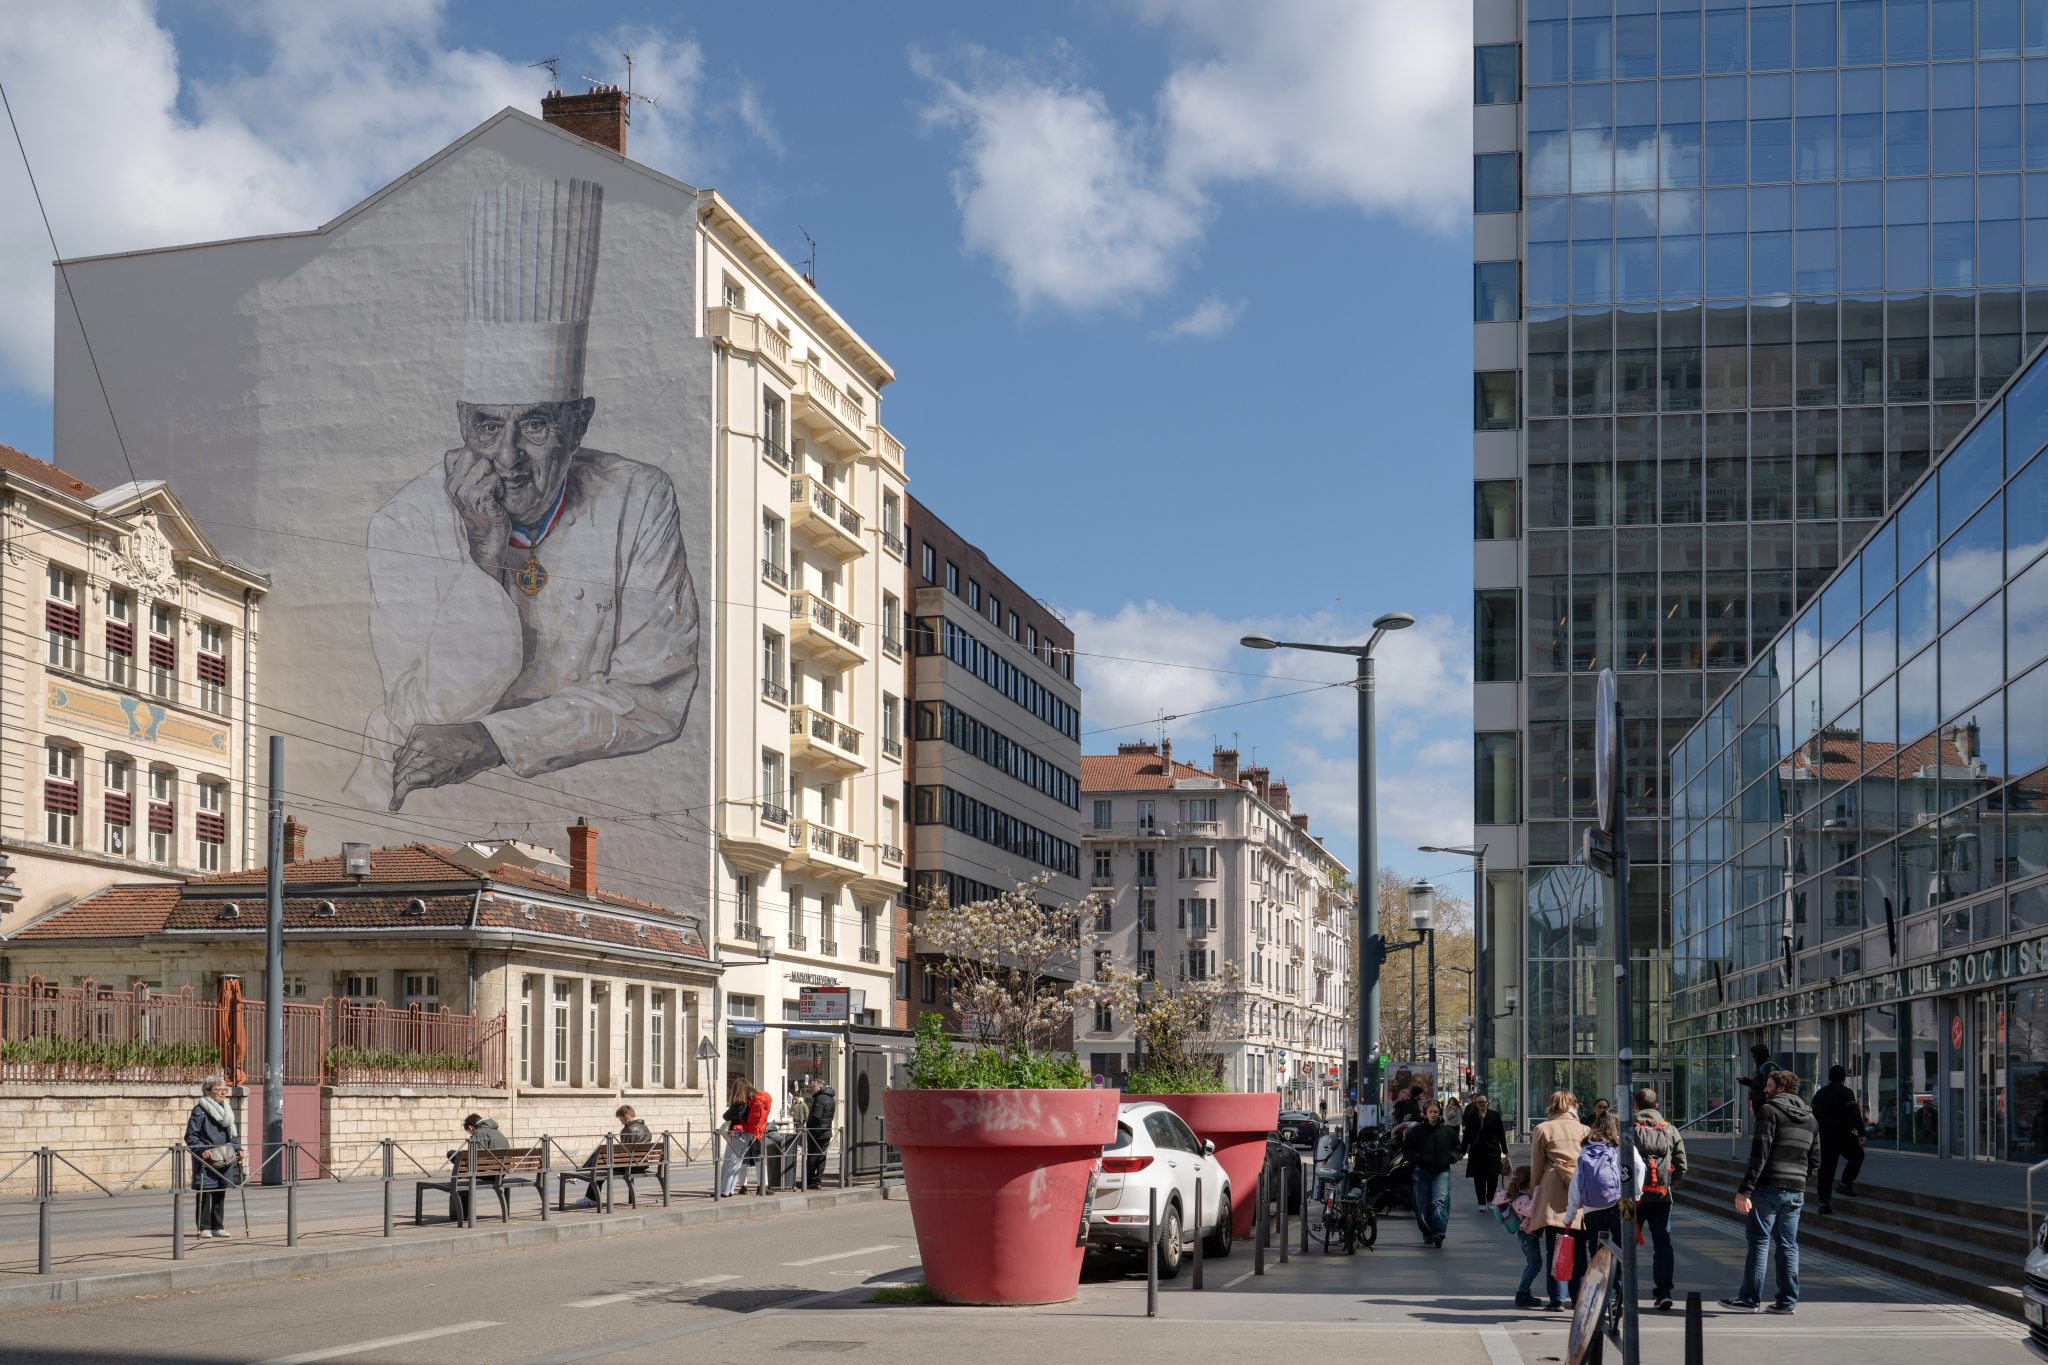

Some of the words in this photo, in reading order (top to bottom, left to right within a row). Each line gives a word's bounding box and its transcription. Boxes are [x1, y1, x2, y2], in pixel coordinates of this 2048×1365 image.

[595, 600, 613, 614] Paul
[1721, 1008, 1738, 1029] LES
[1746, 997, 1789, 1025] HALLES
[1800, 991, 1814, 1016] DE
[1828, 978, 1866, 1010] LYON
[1882, 966, 1931, 998] PAUL
[1950, 936, 2048, 988] BOCUSE
